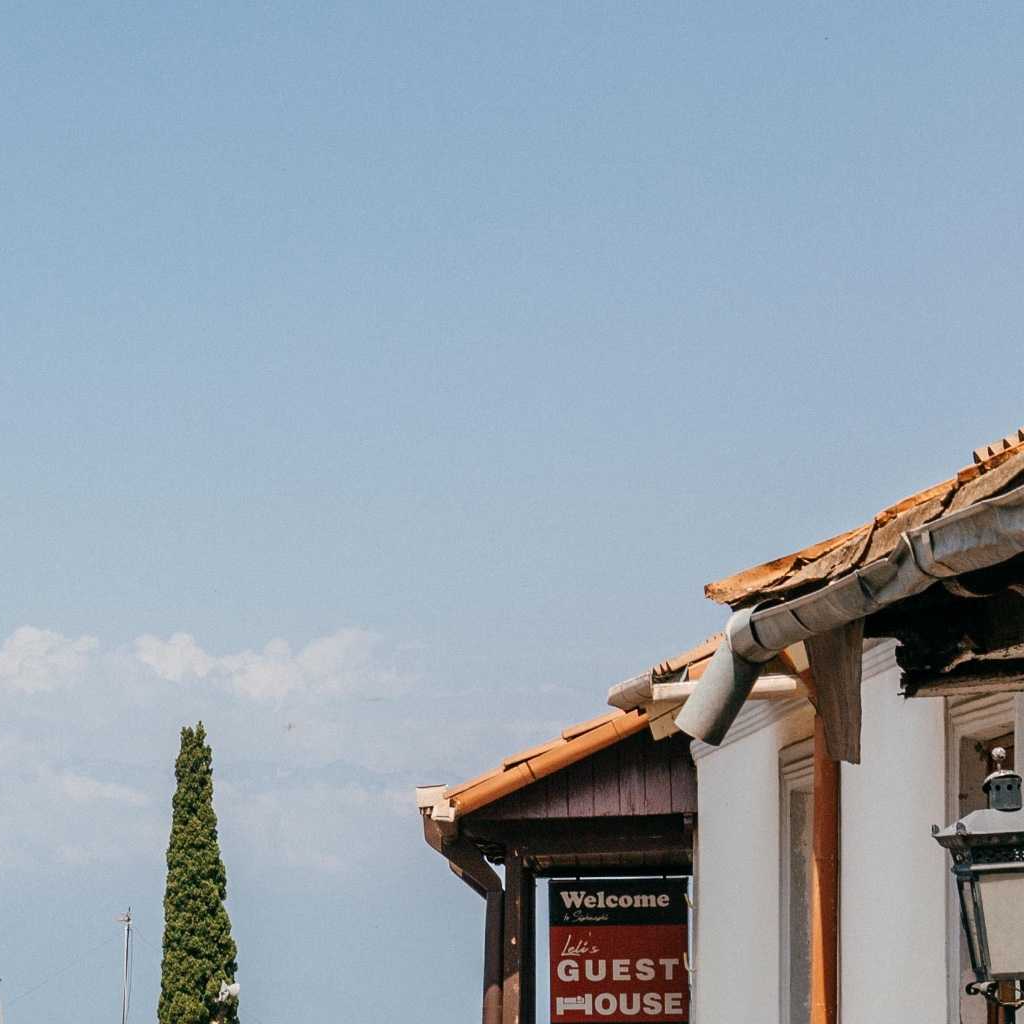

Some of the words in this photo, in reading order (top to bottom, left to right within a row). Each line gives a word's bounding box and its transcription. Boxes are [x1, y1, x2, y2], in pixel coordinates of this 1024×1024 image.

[559, 891, 670, 909] Welcome
[557, 958, 679, 982] GUEST
[556, 992, 683, 1016] HOUSE
